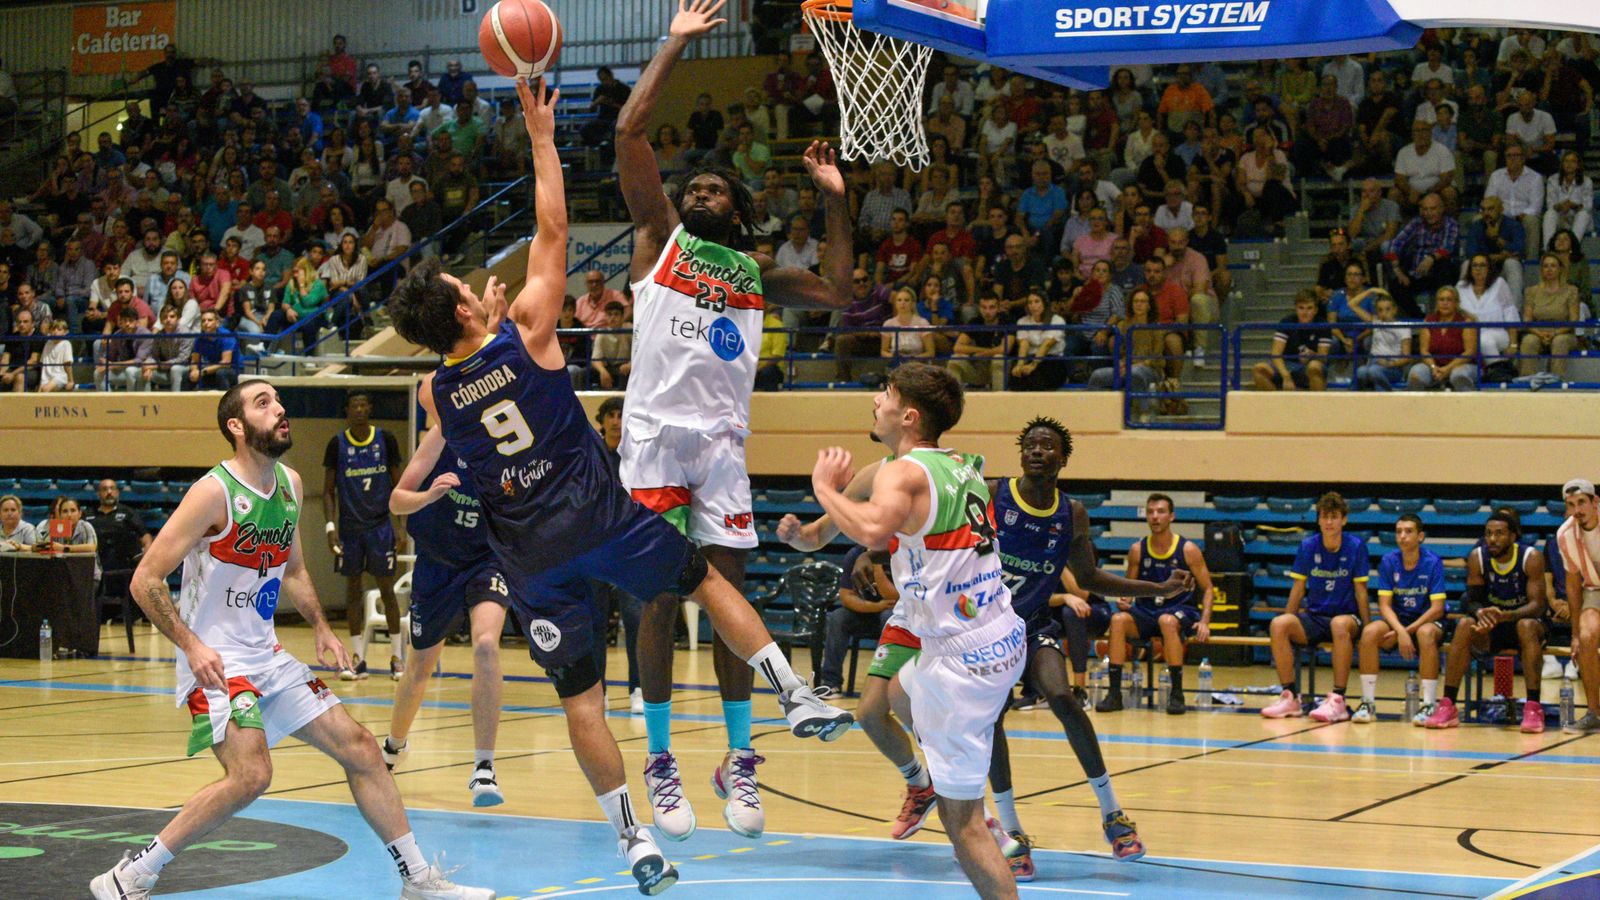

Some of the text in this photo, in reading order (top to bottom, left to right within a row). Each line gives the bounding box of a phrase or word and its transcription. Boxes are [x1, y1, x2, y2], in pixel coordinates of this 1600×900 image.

[105, 6, 142, 28] Bar
[77, 26, 170, 55] Cafetería
[695, 281, 728, 313] 23
[450, 364, 517, 410] CÓRDOBA
[34, 404, 160, 418] PRENSA TV
[480, 399, 535, 457] 9
[362, 477, 372, 491] 7
[454, 510, 480, 528] 15
[387, 556, 394, 570] 7
